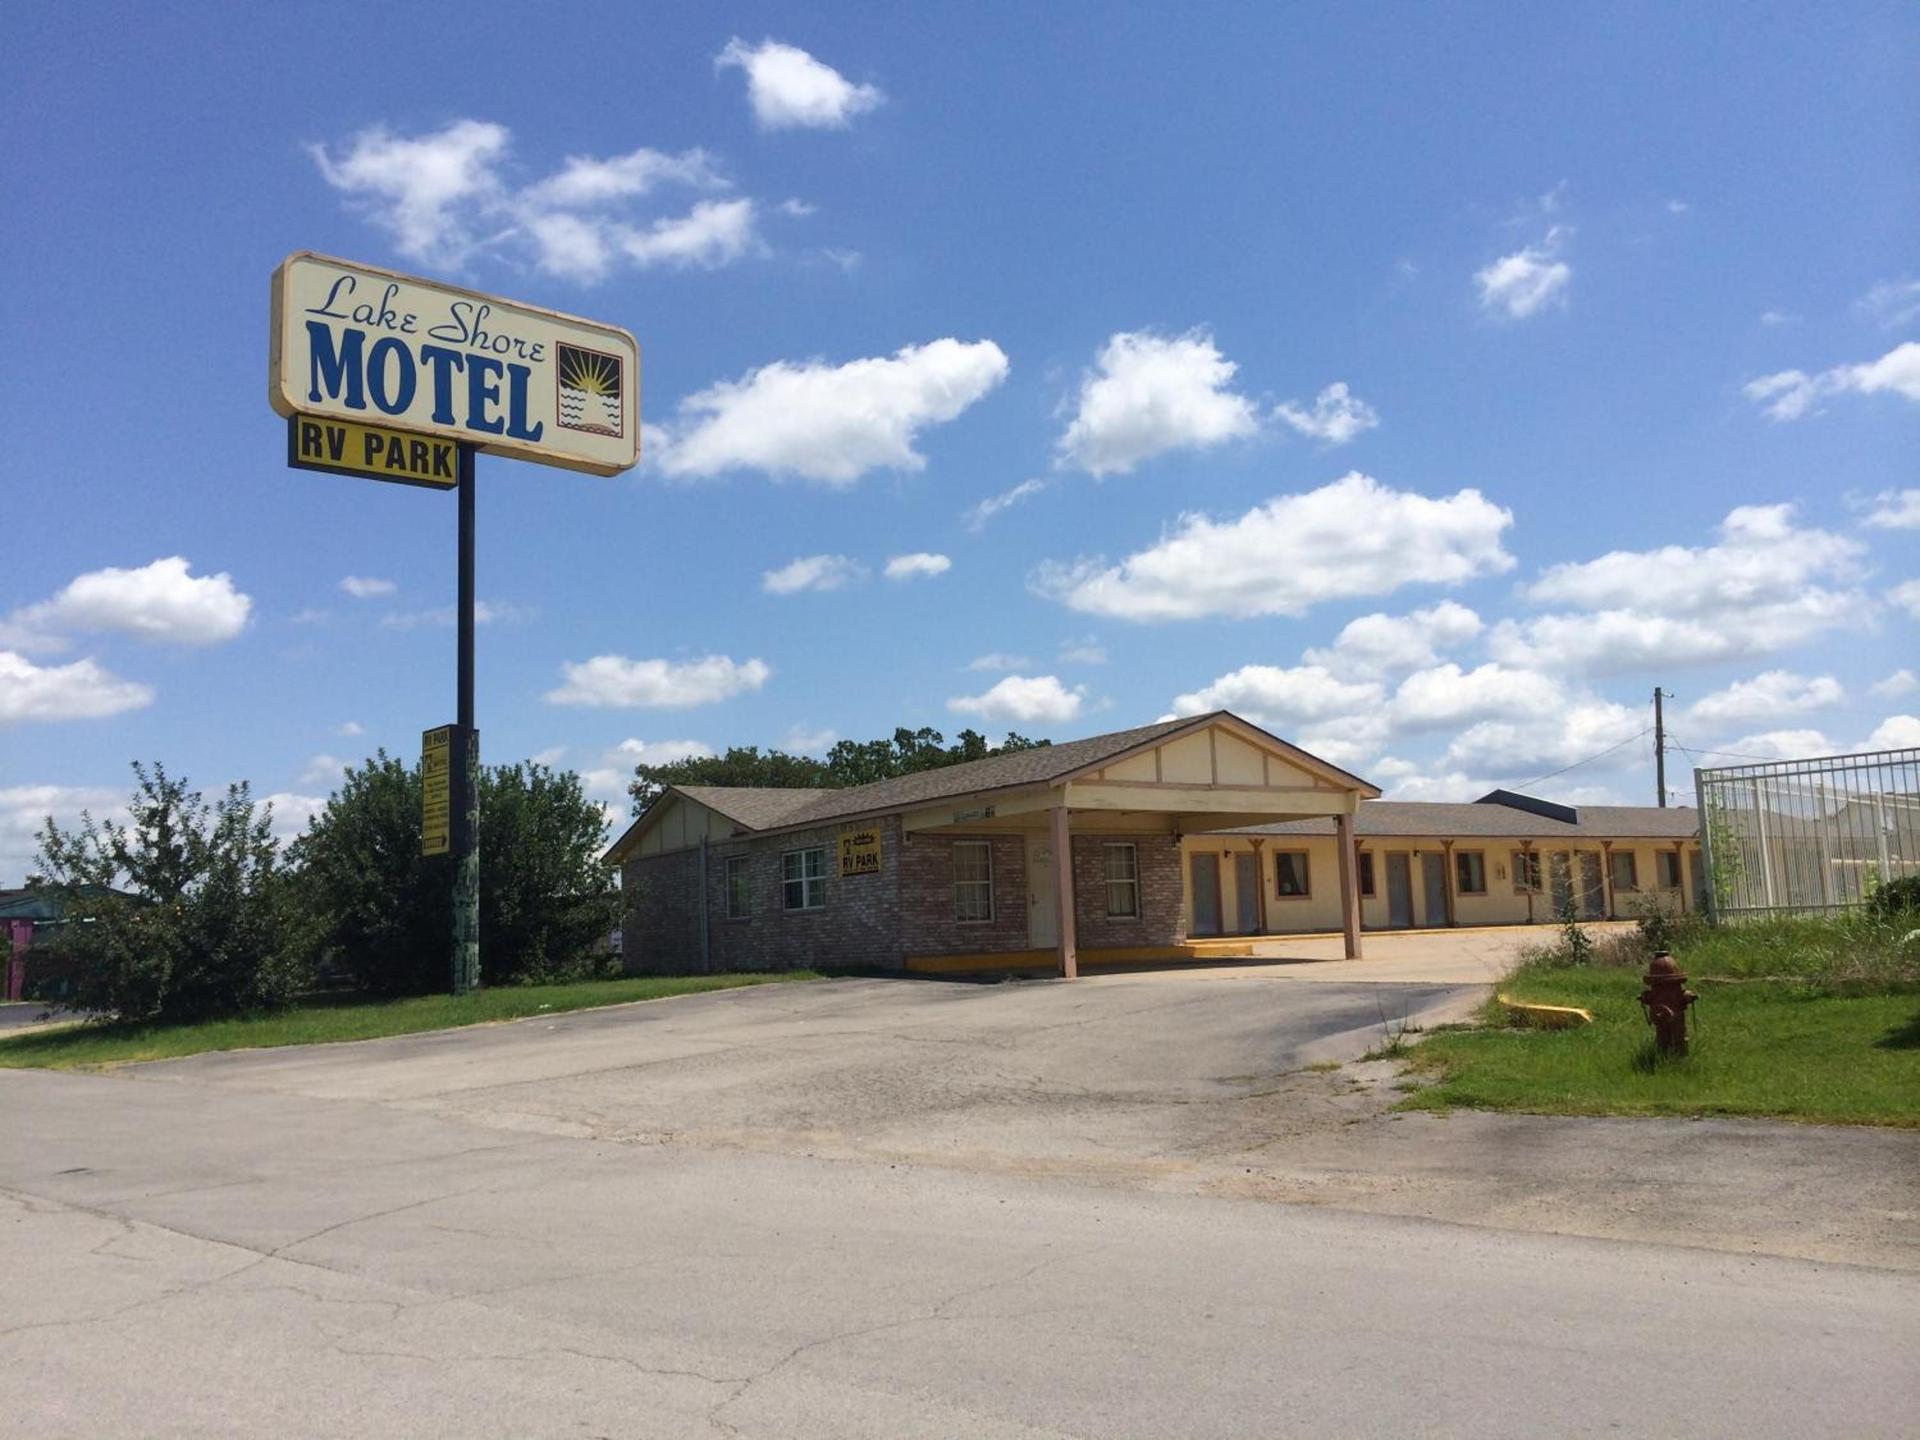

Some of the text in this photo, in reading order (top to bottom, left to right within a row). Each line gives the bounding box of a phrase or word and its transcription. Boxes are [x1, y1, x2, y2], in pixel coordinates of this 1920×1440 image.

[305, 275, 546, 362] Lake Shore
[305, 320, 544, 442] MOTEL
[300, 421, 453, 478] RV PARK
[842, 855, 854, 869] RV
[856, 852, 878, 867] PARK
